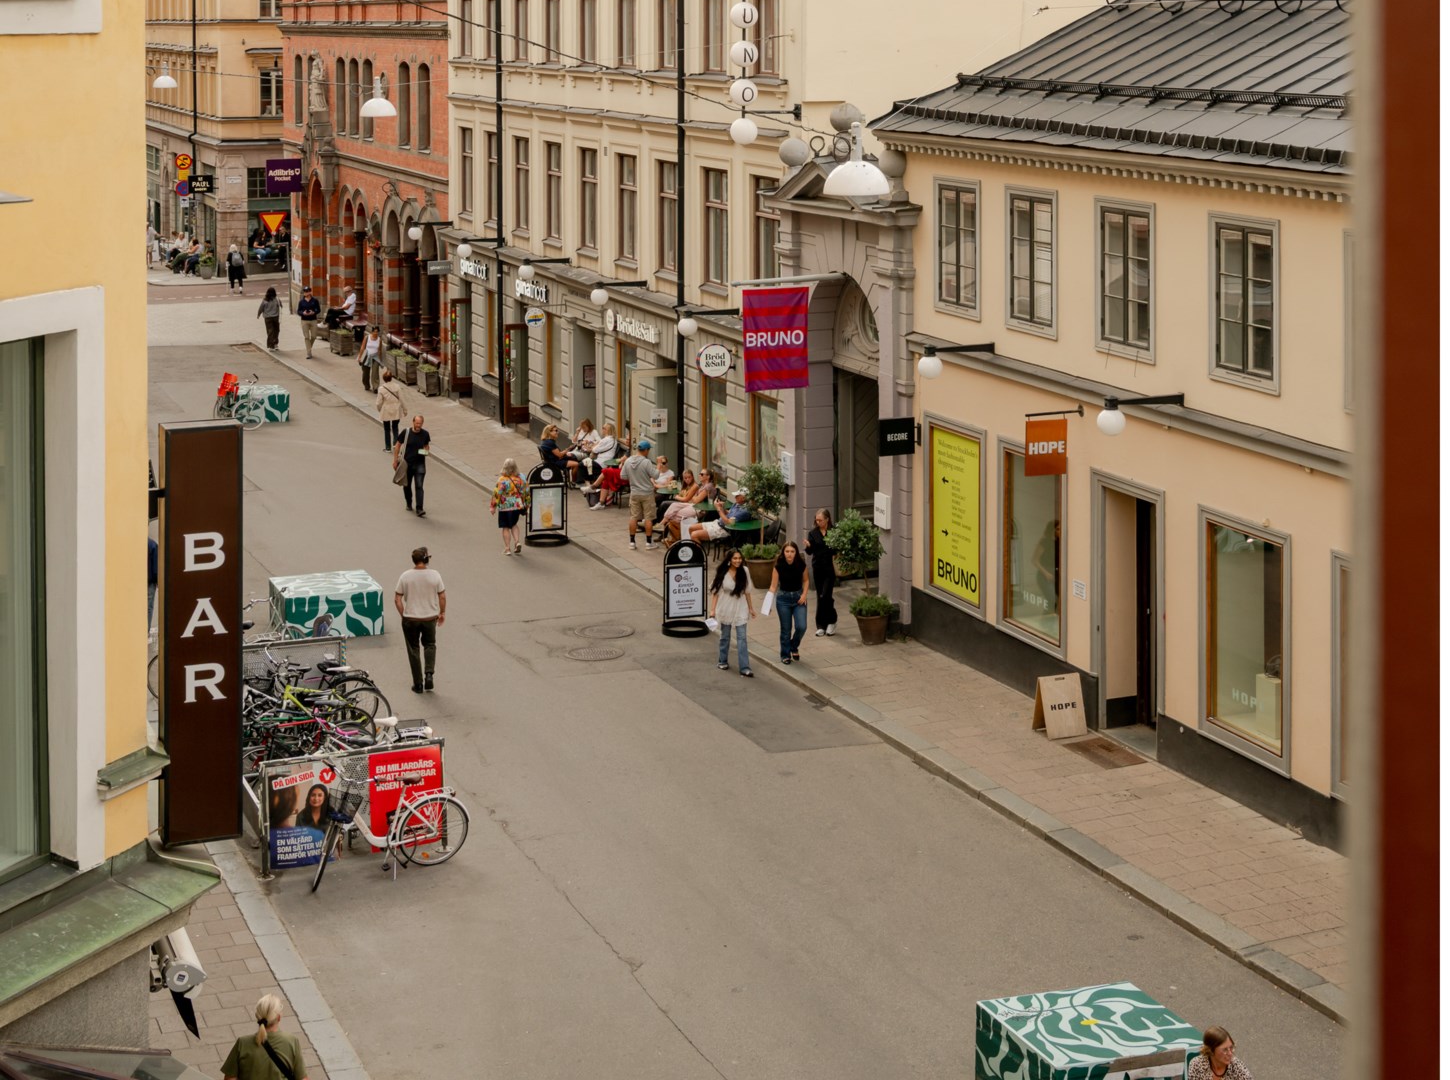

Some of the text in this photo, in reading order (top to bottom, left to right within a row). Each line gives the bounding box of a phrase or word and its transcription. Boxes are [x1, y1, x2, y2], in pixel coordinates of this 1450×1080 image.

[268, 168, 295, 177] Adlibris
[745, 329, 804, 348] BRUNO
[704, 352, 726, 361] Bröd
[704, 360, 727, 368] &Salt
[886, 432, 909, 442] BECORE
[1028, 440, 1065, 455] HOPE
[937, 558, 978, 594] BRUNO
[672, 587, 699, 595] GELATO
[1023, 590, 1049, 611] HOPE
[180, 531, 229, 704] BAR
[1050, 701, 1078, 711] HOPE
[375, 765, 387, 774] EN
[284, 776, 298, 786] DIN
[298, 771, 315, 783] SIDA
[322, 772, 332, 780] V
[276, 846, 292, 854] SOM
